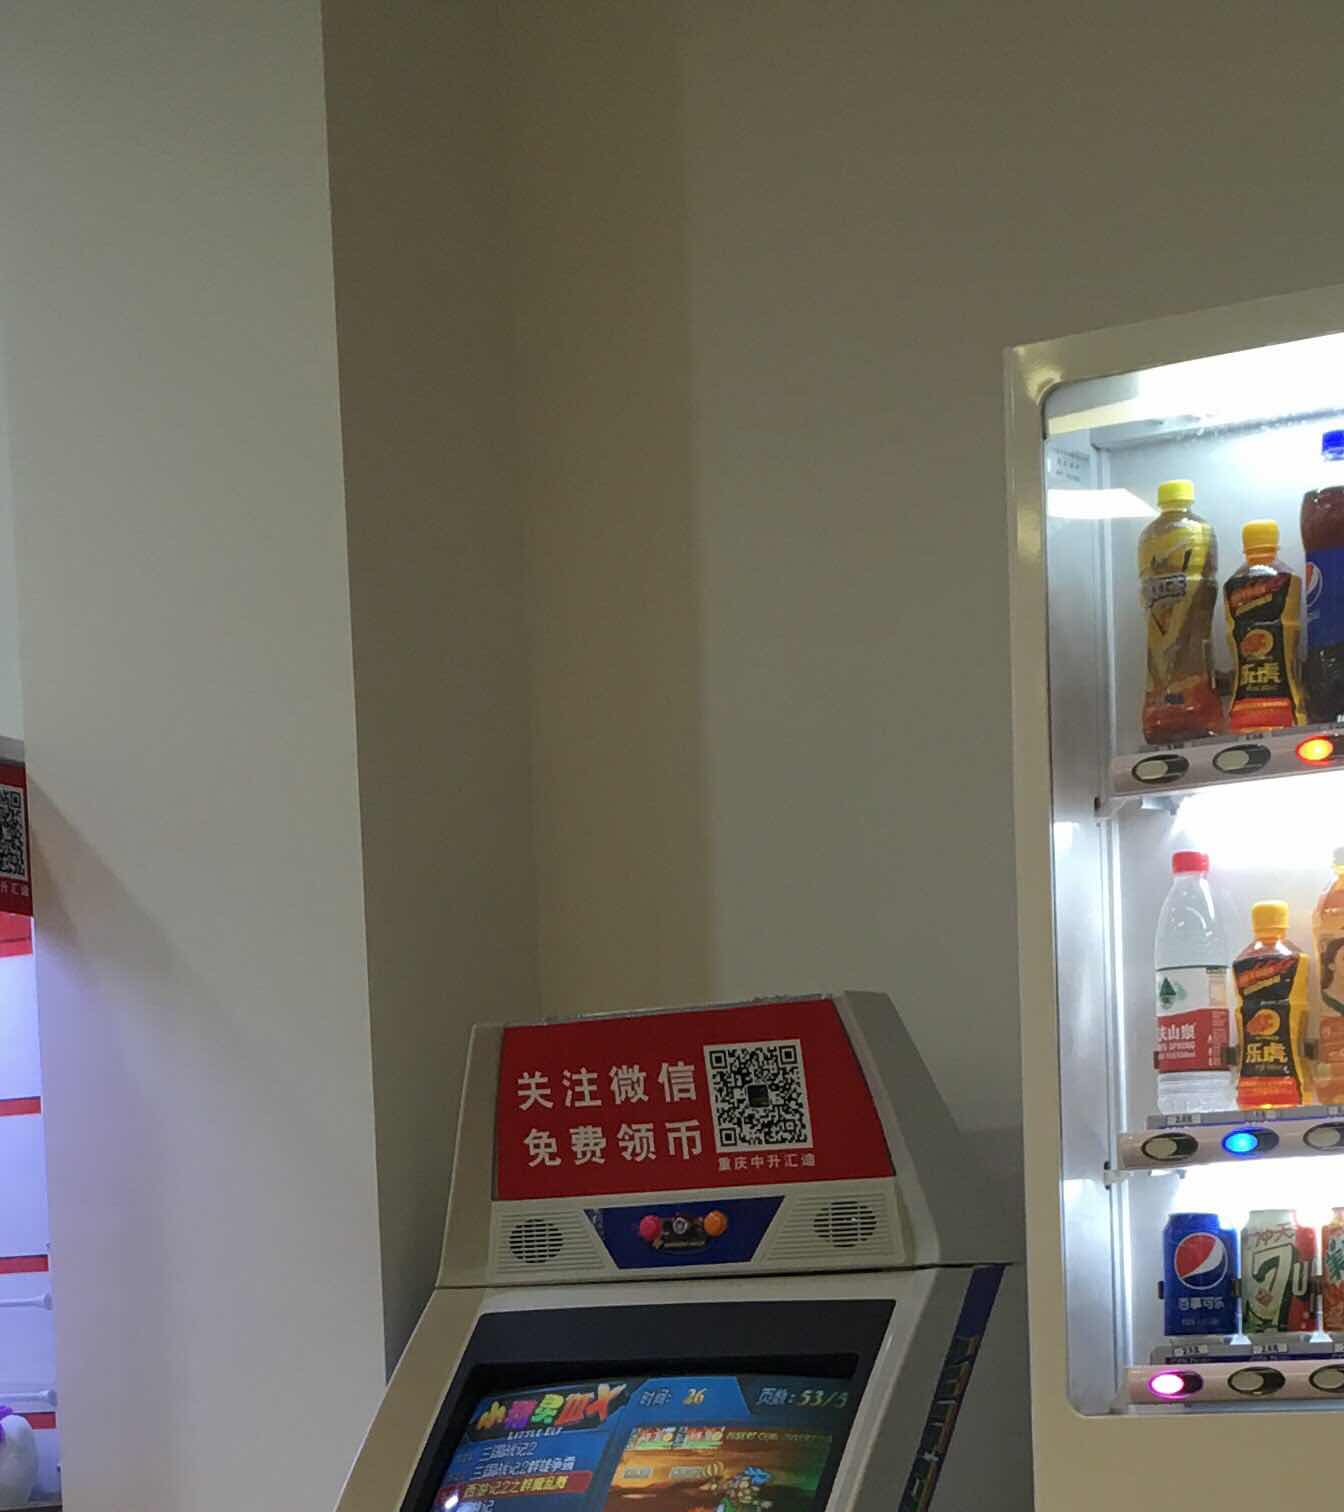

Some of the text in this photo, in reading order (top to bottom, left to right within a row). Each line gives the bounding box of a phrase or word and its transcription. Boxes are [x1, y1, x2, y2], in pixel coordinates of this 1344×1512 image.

[517, 1061, 698, 1111] 关注微信
[523, 1118, 703, 1168] 免费领币
[1178, 1296, 1225, 1311] 百事可乐
